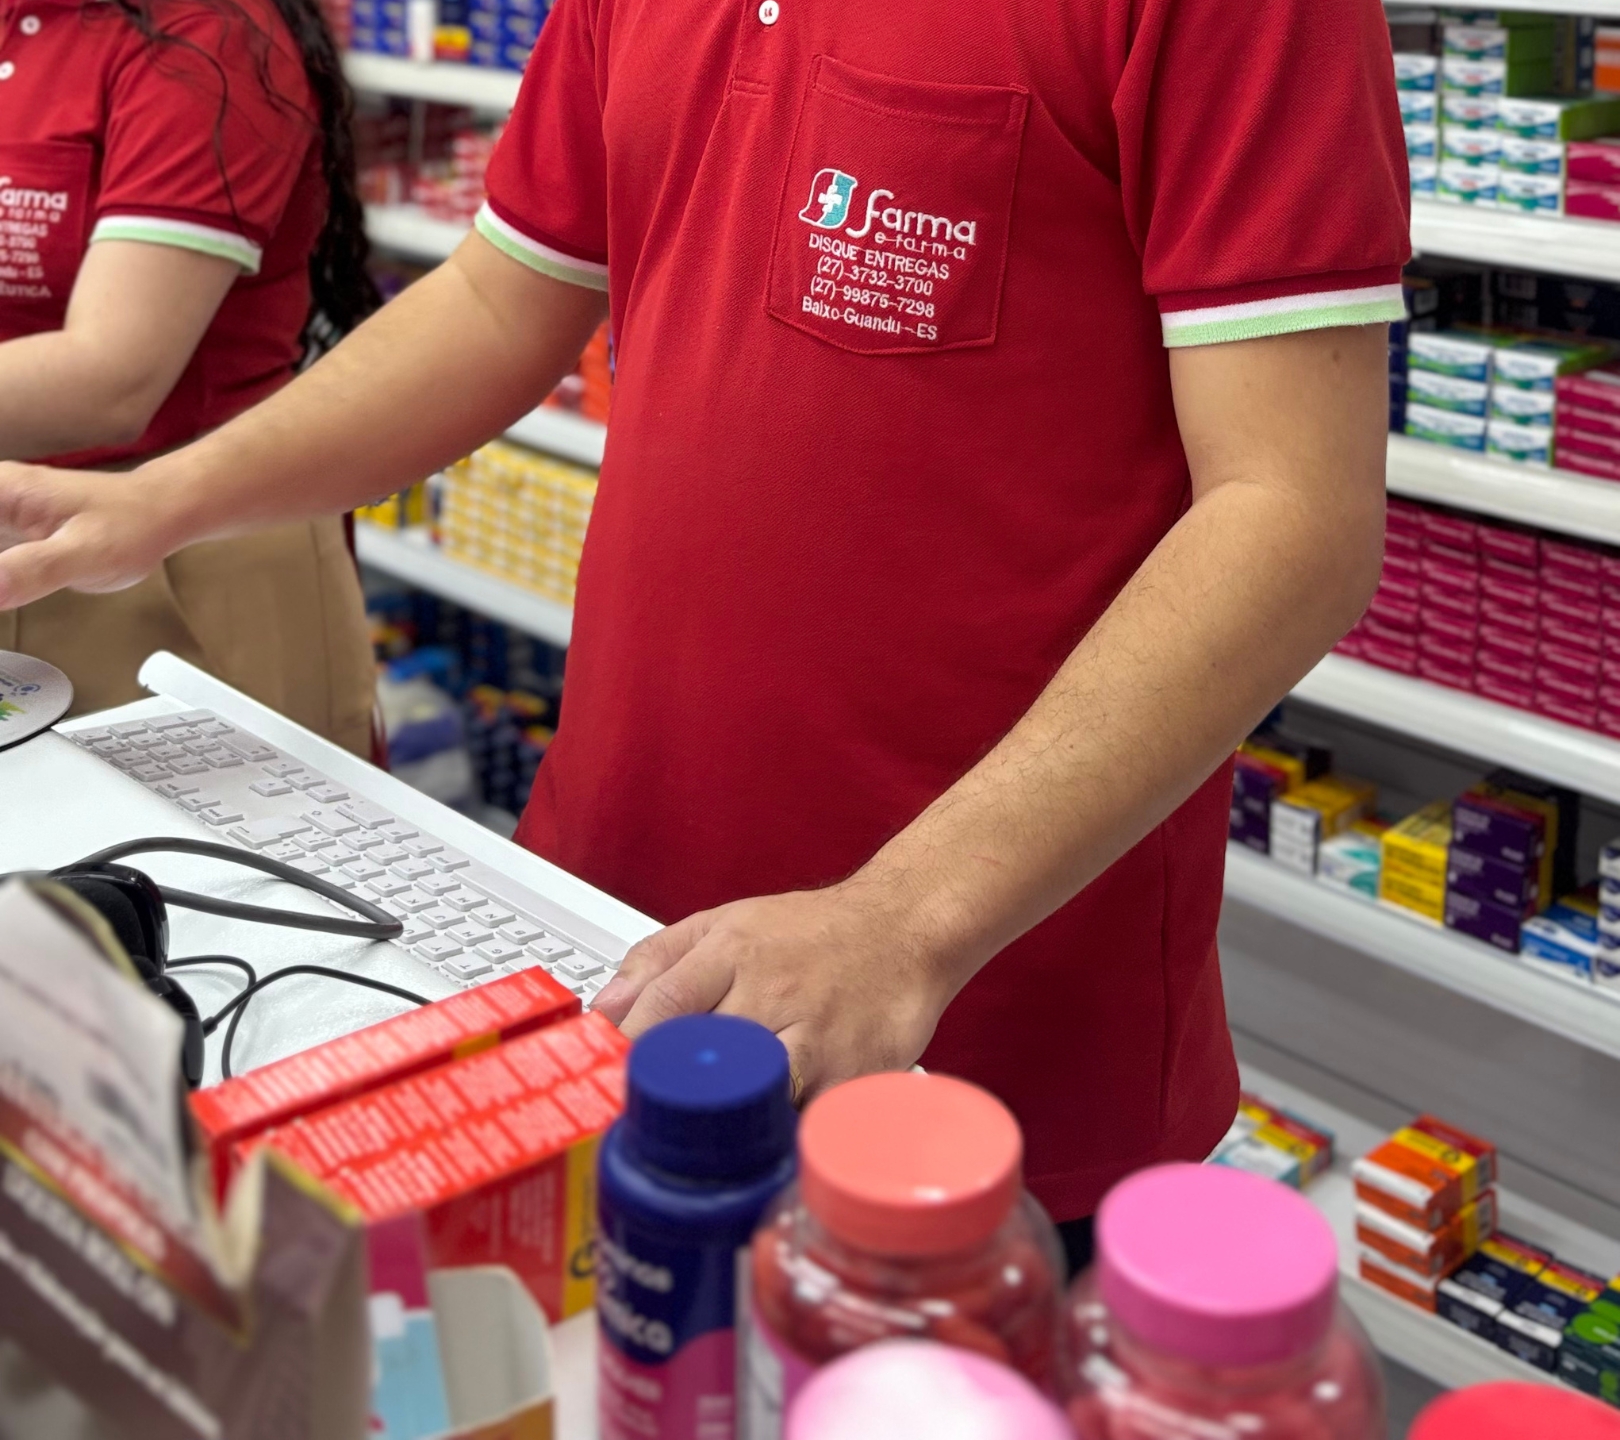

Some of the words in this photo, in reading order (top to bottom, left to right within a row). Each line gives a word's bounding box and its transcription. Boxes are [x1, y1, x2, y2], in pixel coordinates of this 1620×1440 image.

[845, 189, 976, 245] farma
[809, 233, 857, 260] DISQUE
[865, 249, 949, 280] ENTREGAS
